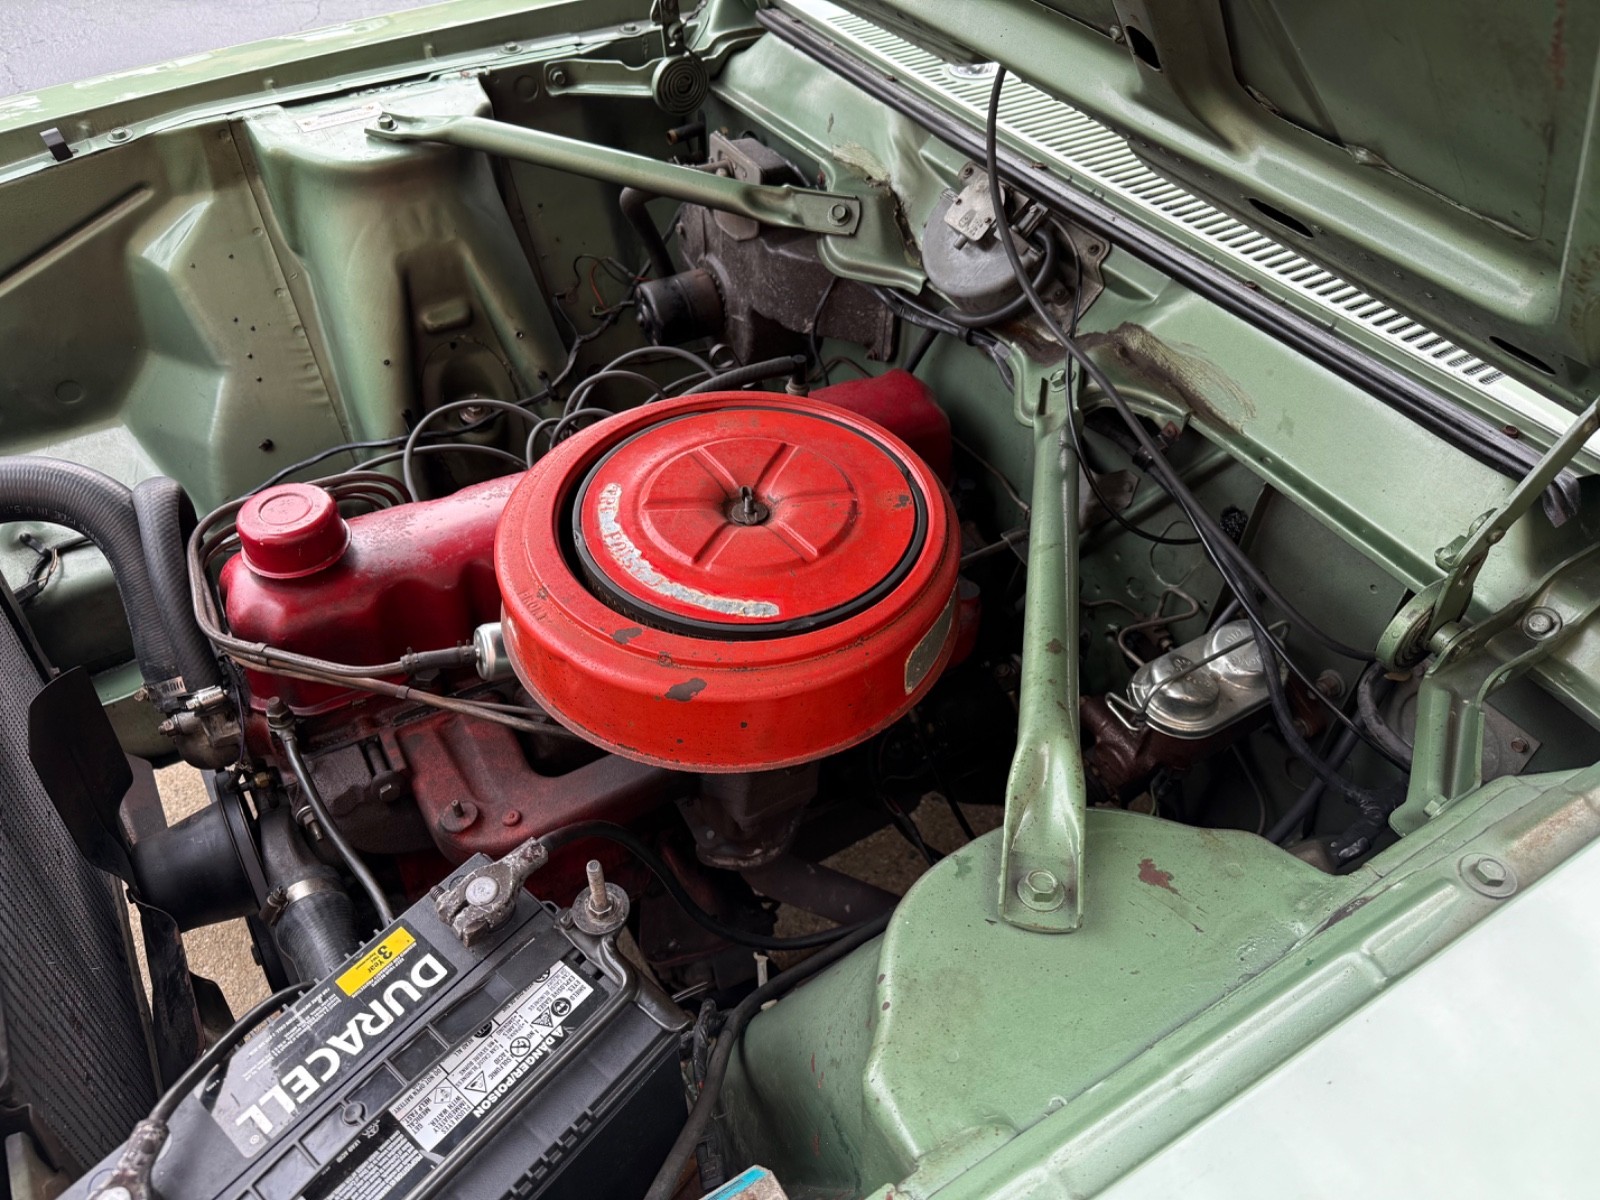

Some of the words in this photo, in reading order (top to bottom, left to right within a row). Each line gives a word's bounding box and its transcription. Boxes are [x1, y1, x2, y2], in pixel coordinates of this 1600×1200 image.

[375, 943, 394, 961] 3
[366, 958, 384, 974] Year
[233, 952, 448, 1135] DURACELL
[471, 1035, 555, 1118] DANGER/POISON
[416, 1096, 432, 1111] HELP
[446, 1094, 462, 1110] WITH
[406, 1106, 431, 1129] MEDICAL
[431, 1100, 467, 1133] IMMEDIATELY
[453, 1104, 471, 1122] FLUSH
[410, 1122, 423, 1135] GET
[440, 1119, 455, 1135] EYES
